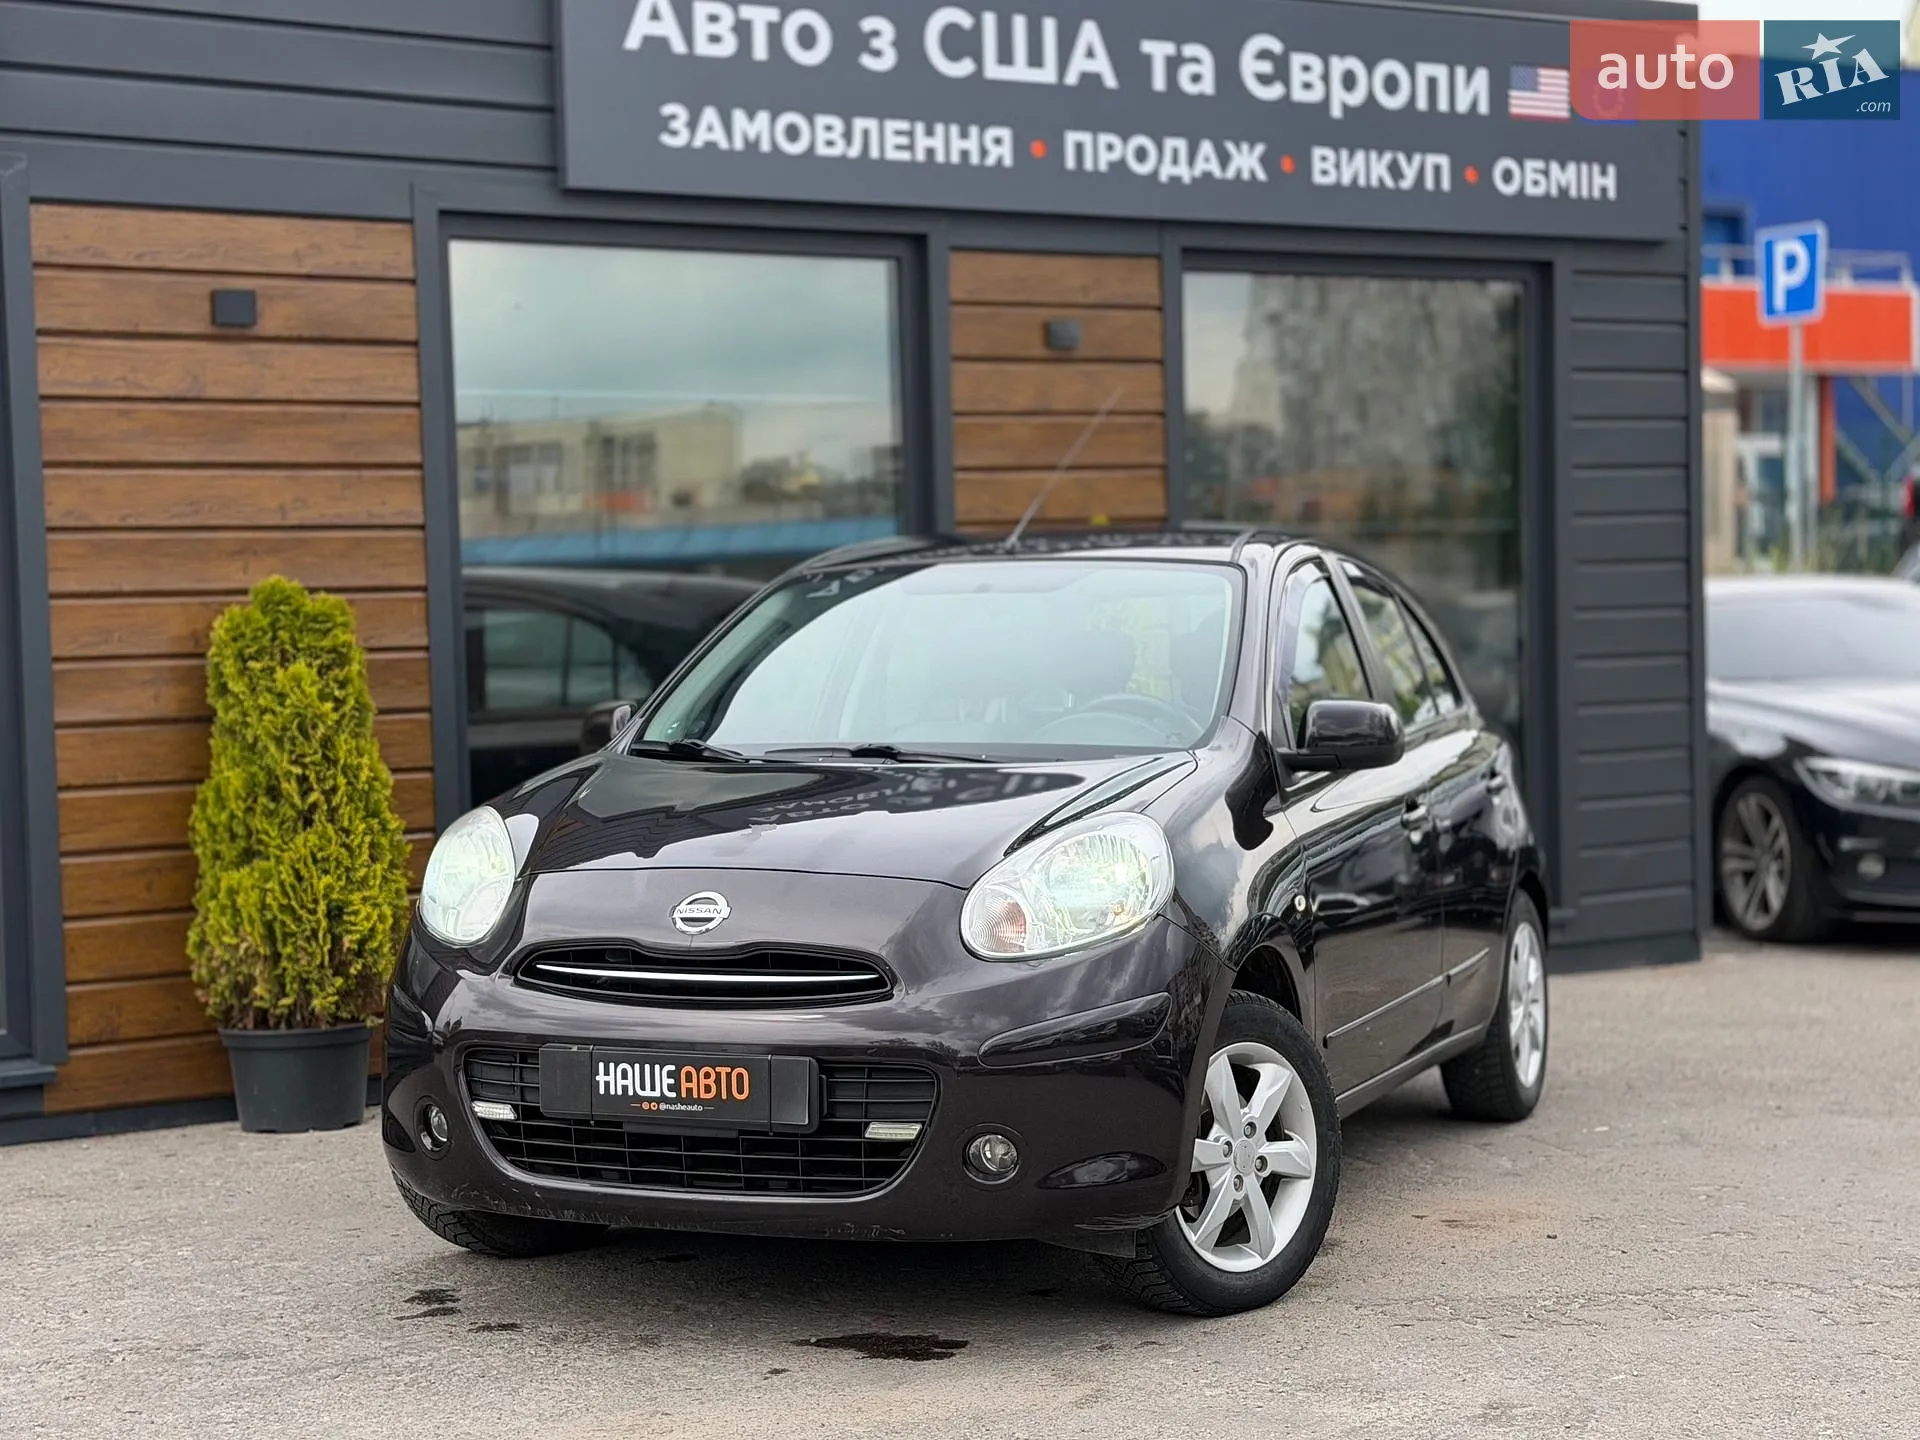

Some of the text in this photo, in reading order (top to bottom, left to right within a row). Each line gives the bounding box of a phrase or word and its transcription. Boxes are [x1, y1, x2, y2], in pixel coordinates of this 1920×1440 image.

[622, 0, 1490, 119] Авто з США та Європи
[658, 102, 1617, 200] ЗАМОВЛЕННЯ ПРОДАЖ ВИКУП ОБМІН
[1773, 240, 1811, 312] P
[675, 906, 722, 915] NISSAN
[596, 1061, 750, 1100] НАШЕ АВТО
[659, 1102, 703, 1111] @nasheauto
